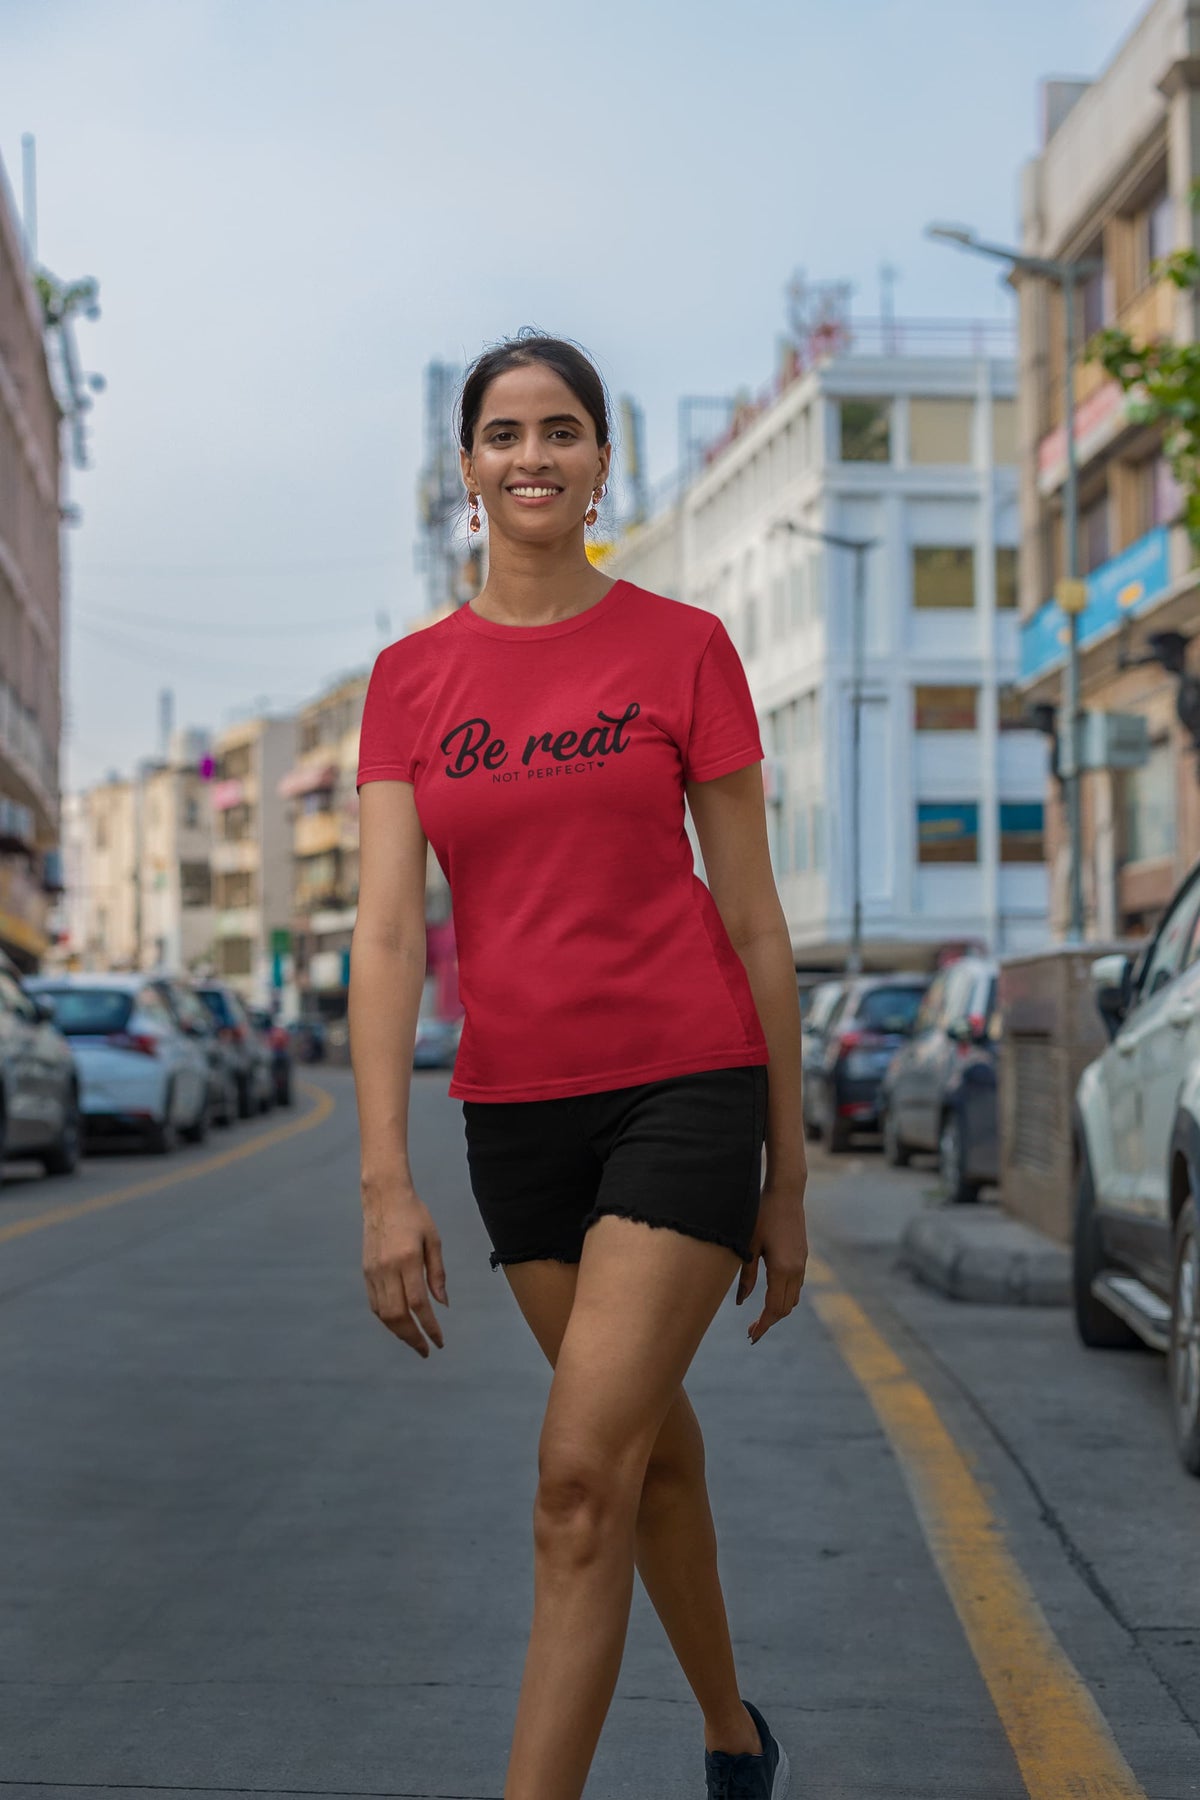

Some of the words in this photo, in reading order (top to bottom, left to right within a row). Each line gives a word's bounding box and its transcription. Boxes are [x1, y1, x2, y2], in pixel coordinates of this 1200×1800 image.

[440, 718, 508, 779] Be
[521, 702, 640, 766] real
[492, 771, 520, 783] NOT
[528, 761, 595, 779] PERFECT
